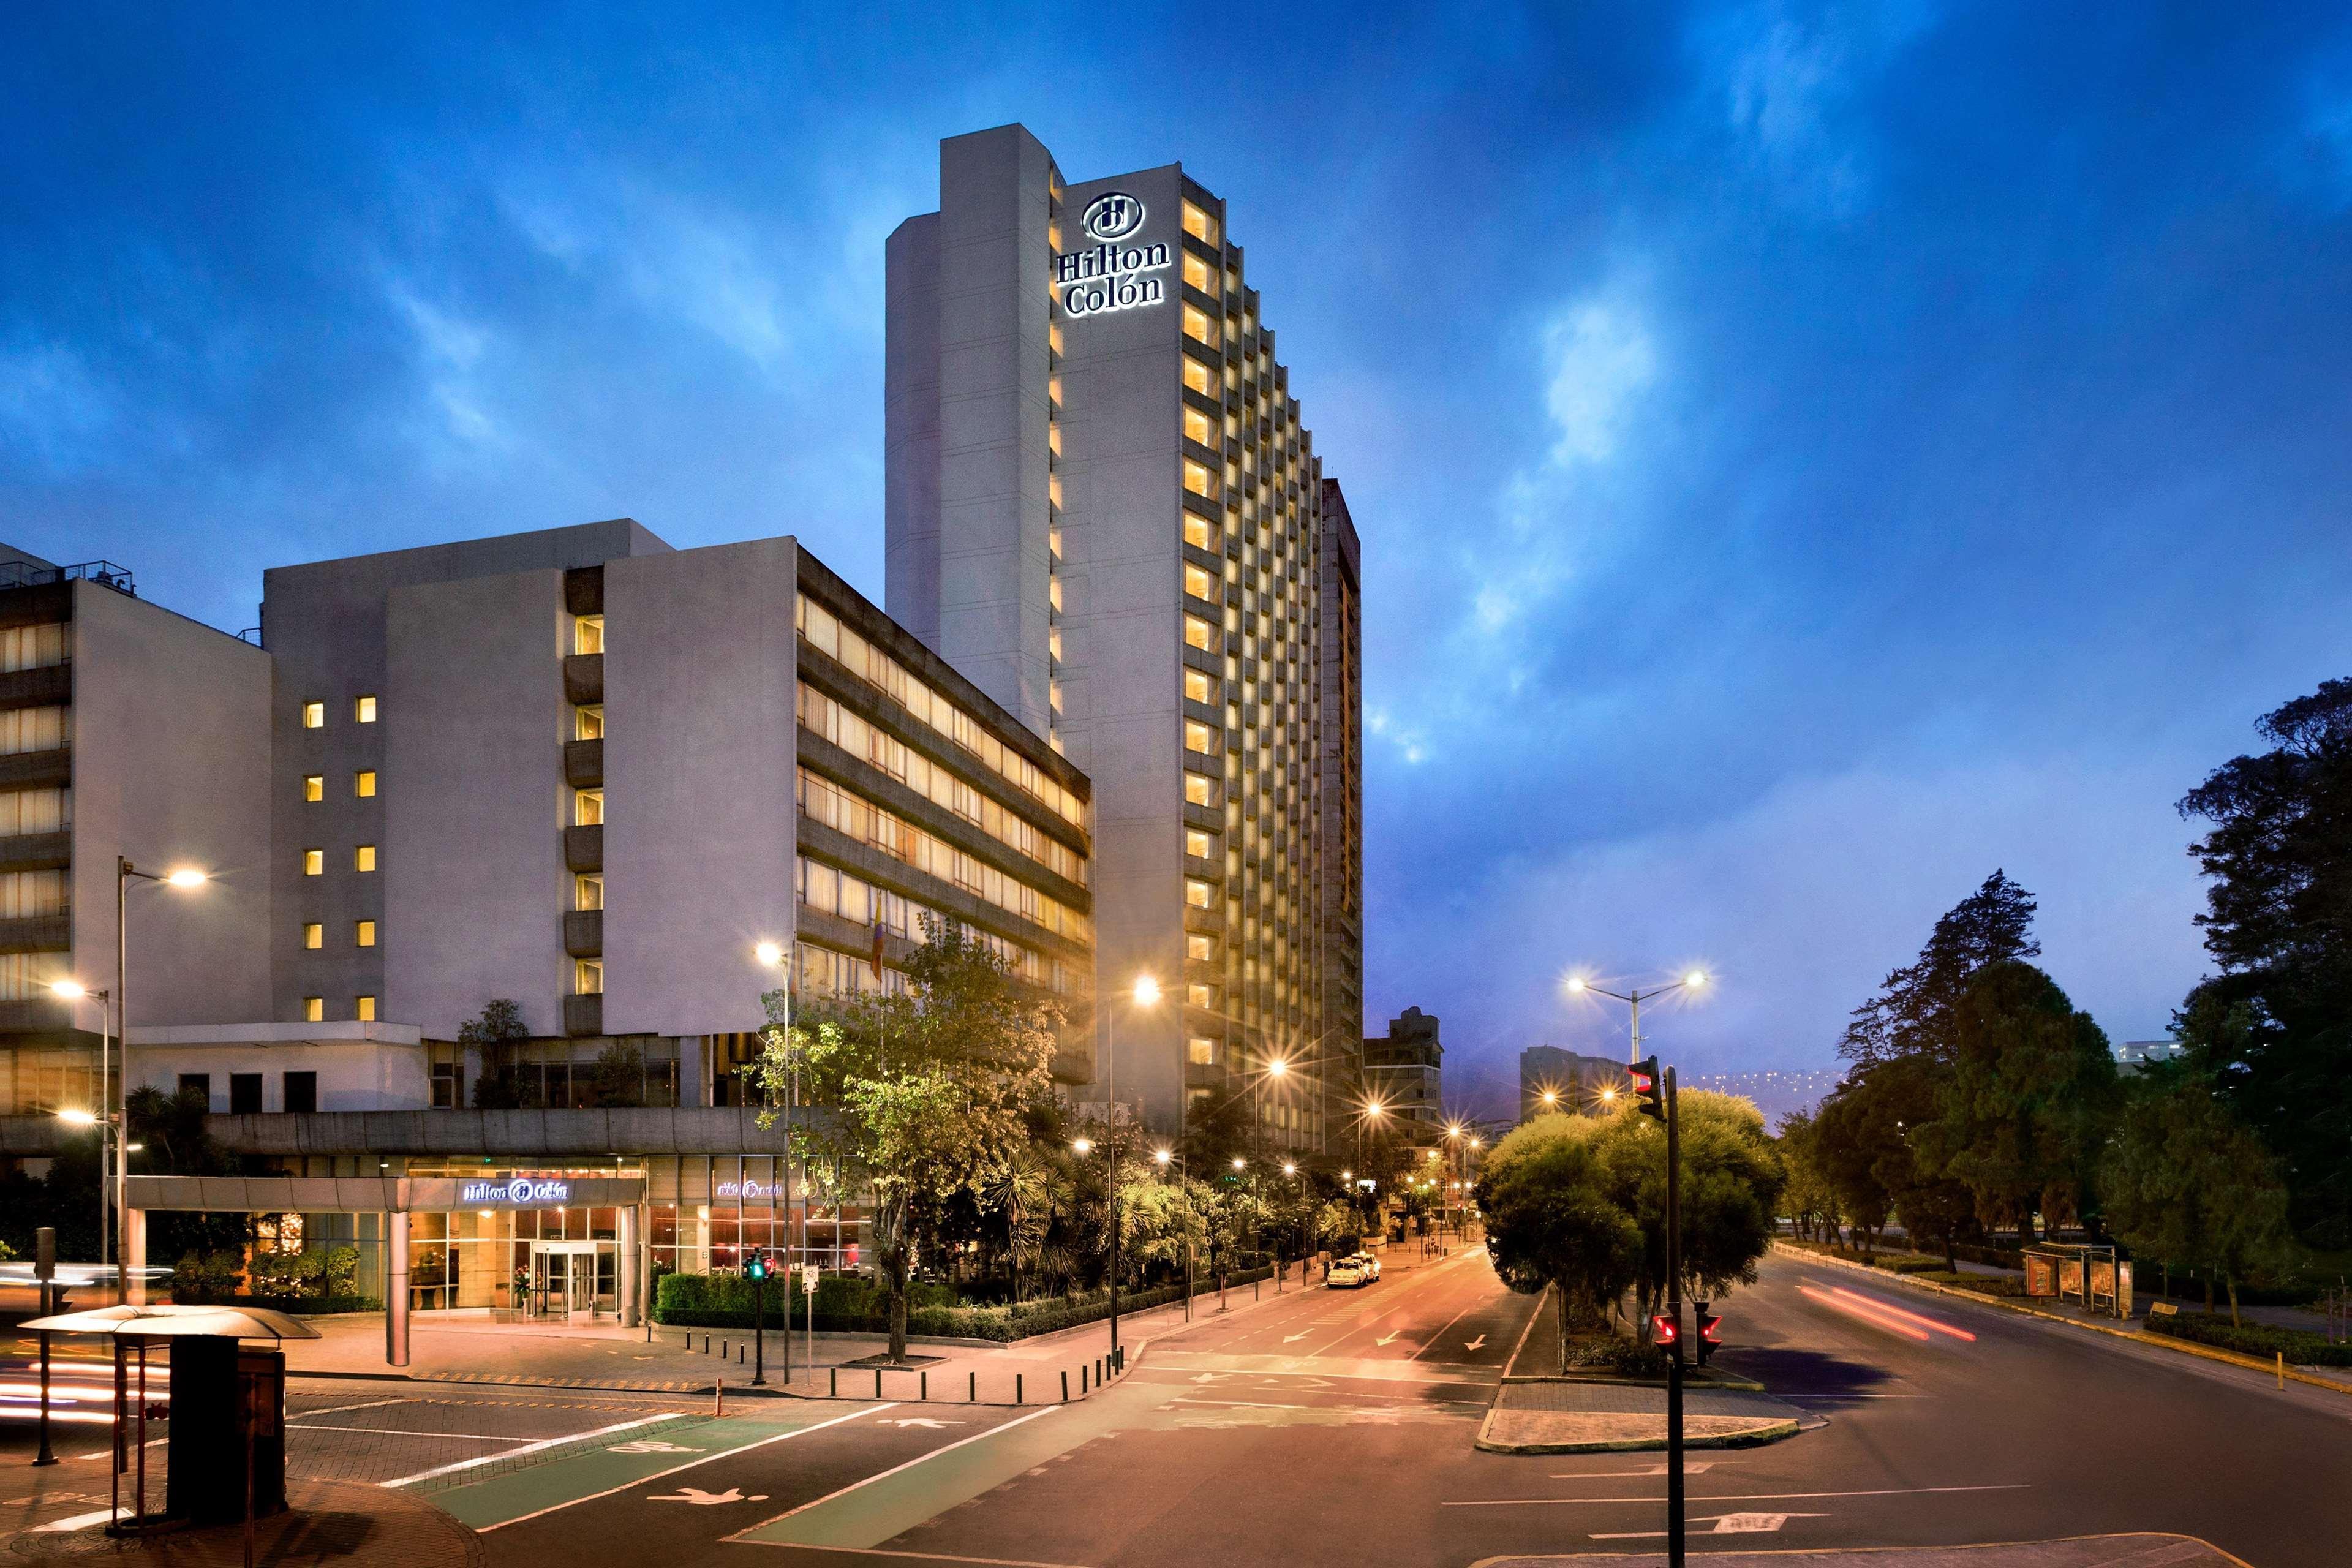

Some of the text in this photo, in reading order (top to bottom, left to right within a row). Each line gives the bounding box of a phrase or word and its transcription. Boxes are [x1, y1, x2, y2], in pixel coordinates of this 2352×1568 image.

[1056, 243, 1170, 284] Hilton
[1065, 274, 1163, 314] Colón
[466, 1183, 509, 1200] Hilton
[535, 1183, 568, 1199] Colón
